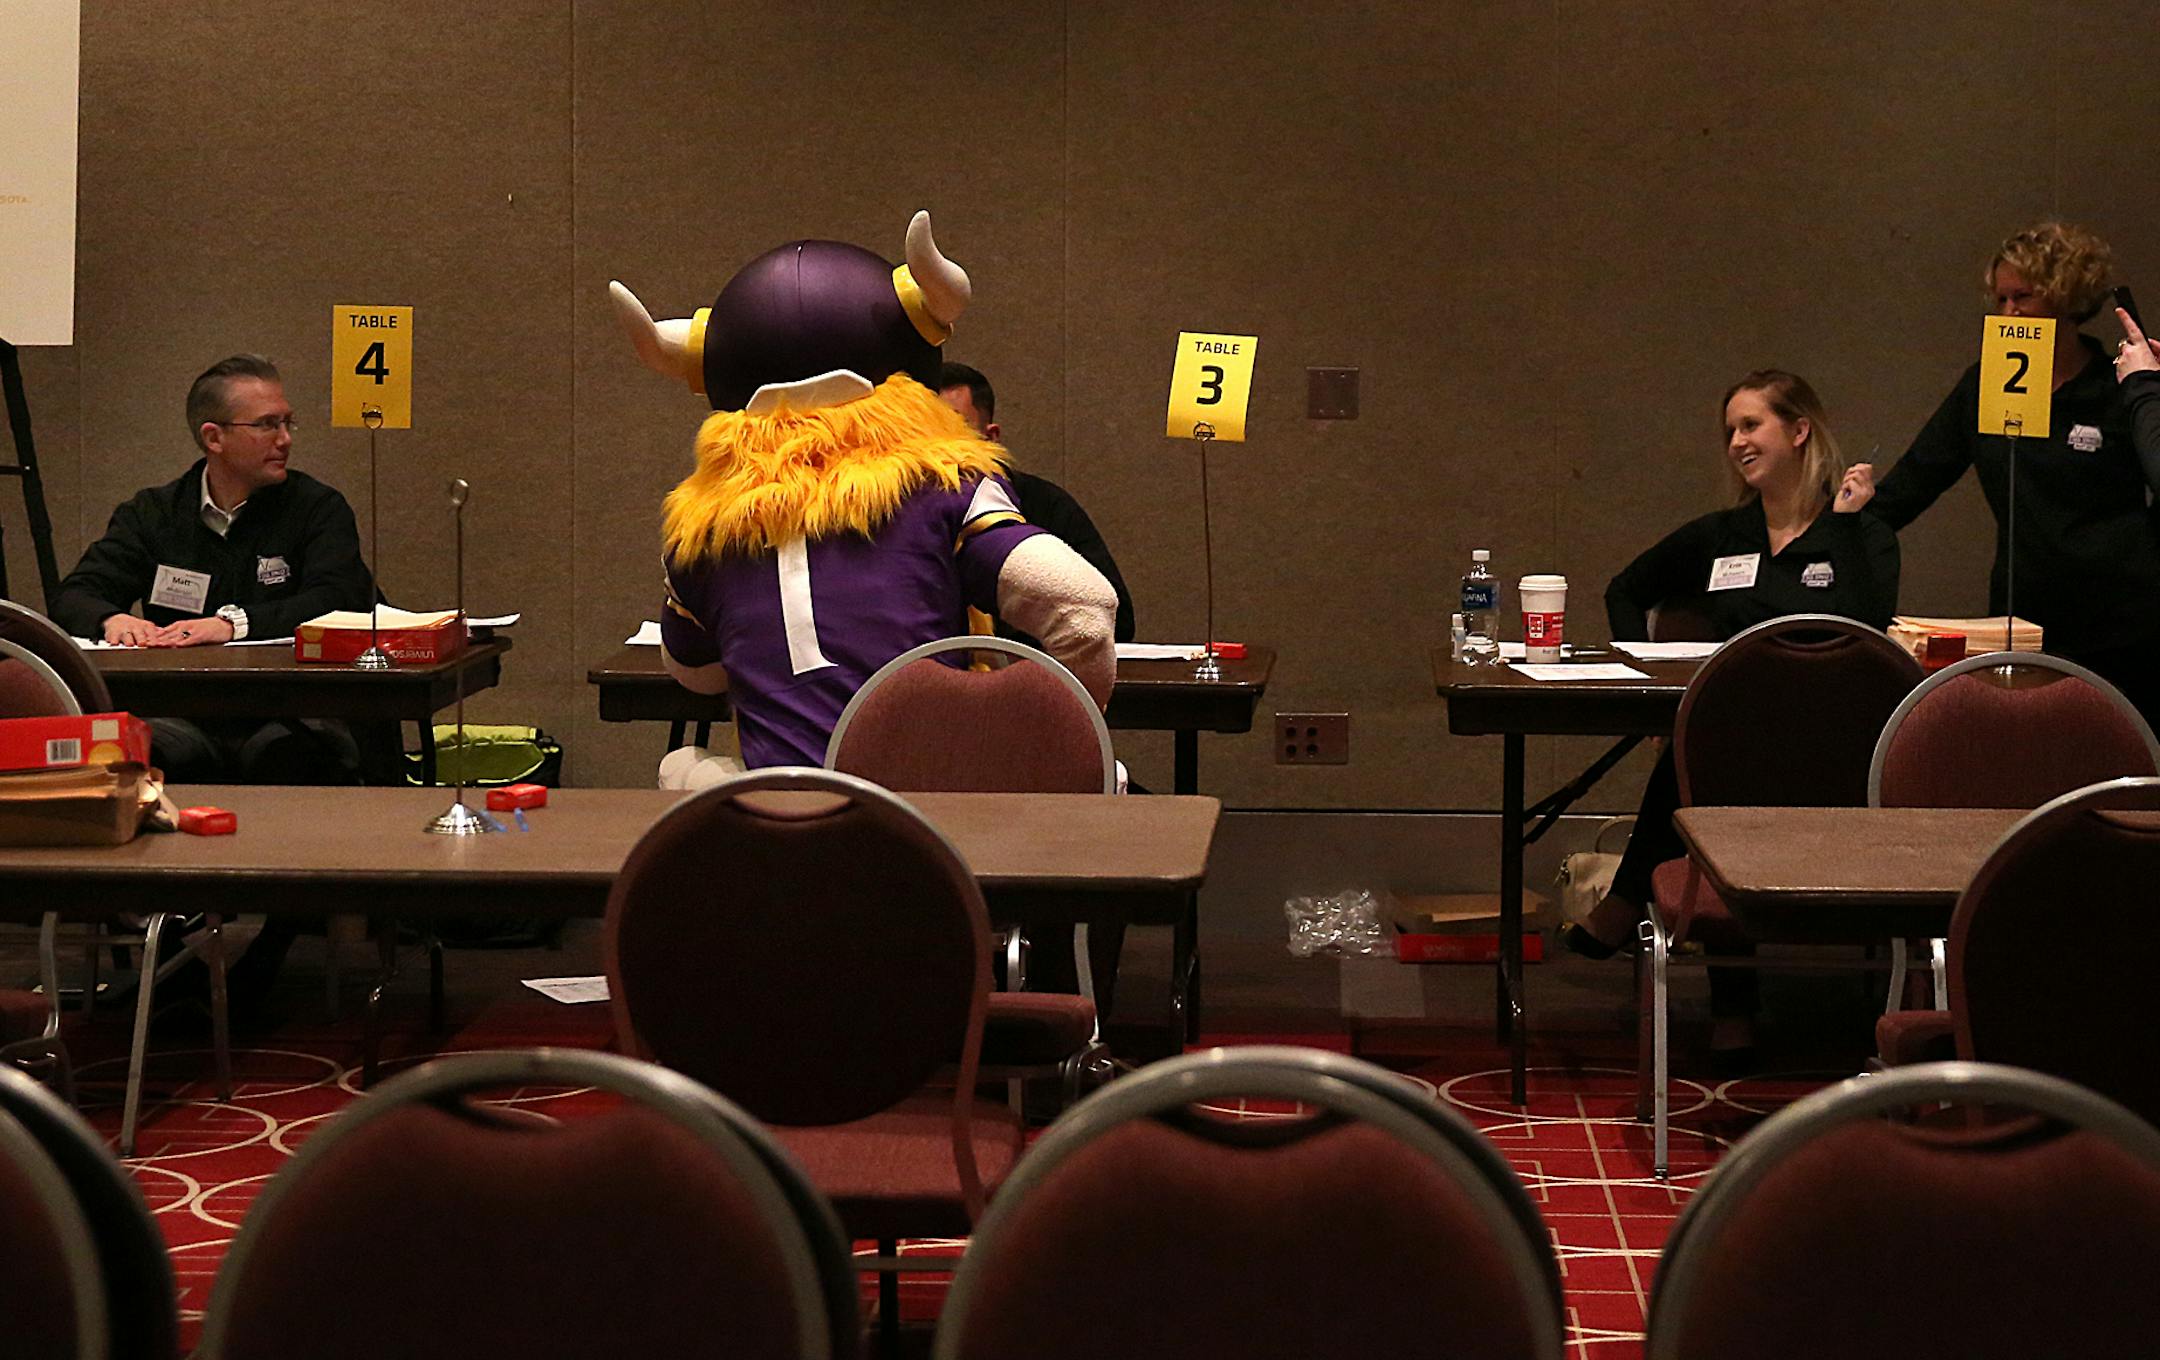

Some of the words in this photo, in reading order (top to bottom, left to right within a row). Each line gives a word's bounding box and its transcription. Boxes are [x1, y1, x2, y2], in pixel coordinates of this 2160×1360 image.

[350, 315, 397, 328] TABLE
[1999, 325, 2042, 340] TABLE
[1195, 341, 1241, 355] TABLE
[355, 342, 390, 385] 4
[2003, 352, 2030, 394] 2
[1196, 365, 1224, 405] 3
